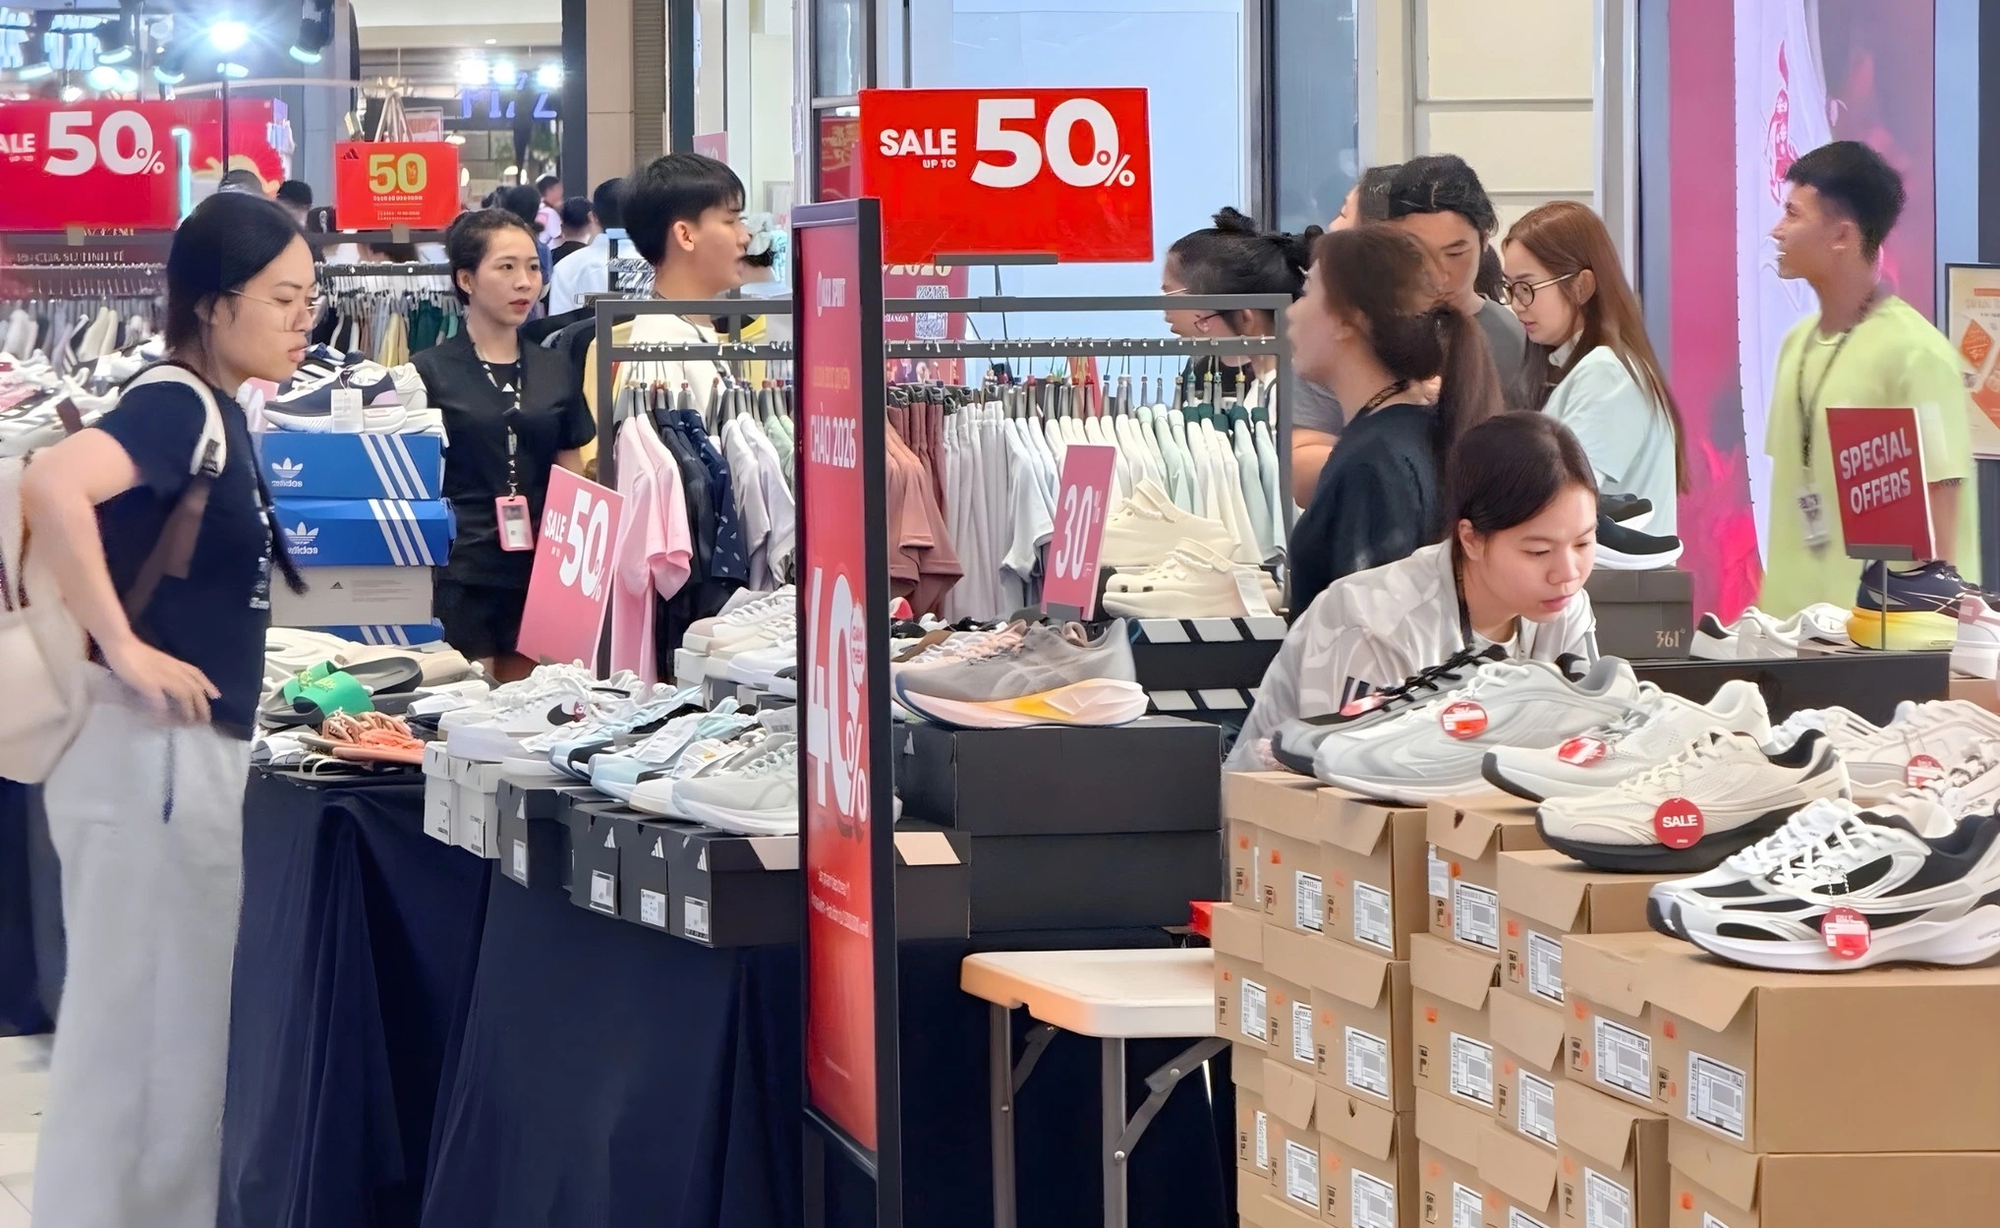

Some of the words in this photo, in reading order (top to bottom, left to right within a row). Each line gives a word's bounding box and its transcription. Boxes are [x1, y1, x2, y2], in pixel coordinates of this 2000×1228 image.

[44, 109, 165, 176] 50%
[879, 128, 957, 157] SALE
[969, 98, 1136, 189] 50%
[922, 158, 939, 169] UP
[940, 158, 957, 169] TO
[810, 401, 831, 465] CHÀO
[832, 416, 857, 469] 2026
[1839, 427, 1913, 480] SPECIAL
[1850, 467, 1911, 515] OFFERS
[544, 508, 567, 544] SALE
[558, 487, 609, 603] 50%
[1662, 814, 1698, 828] SALE
